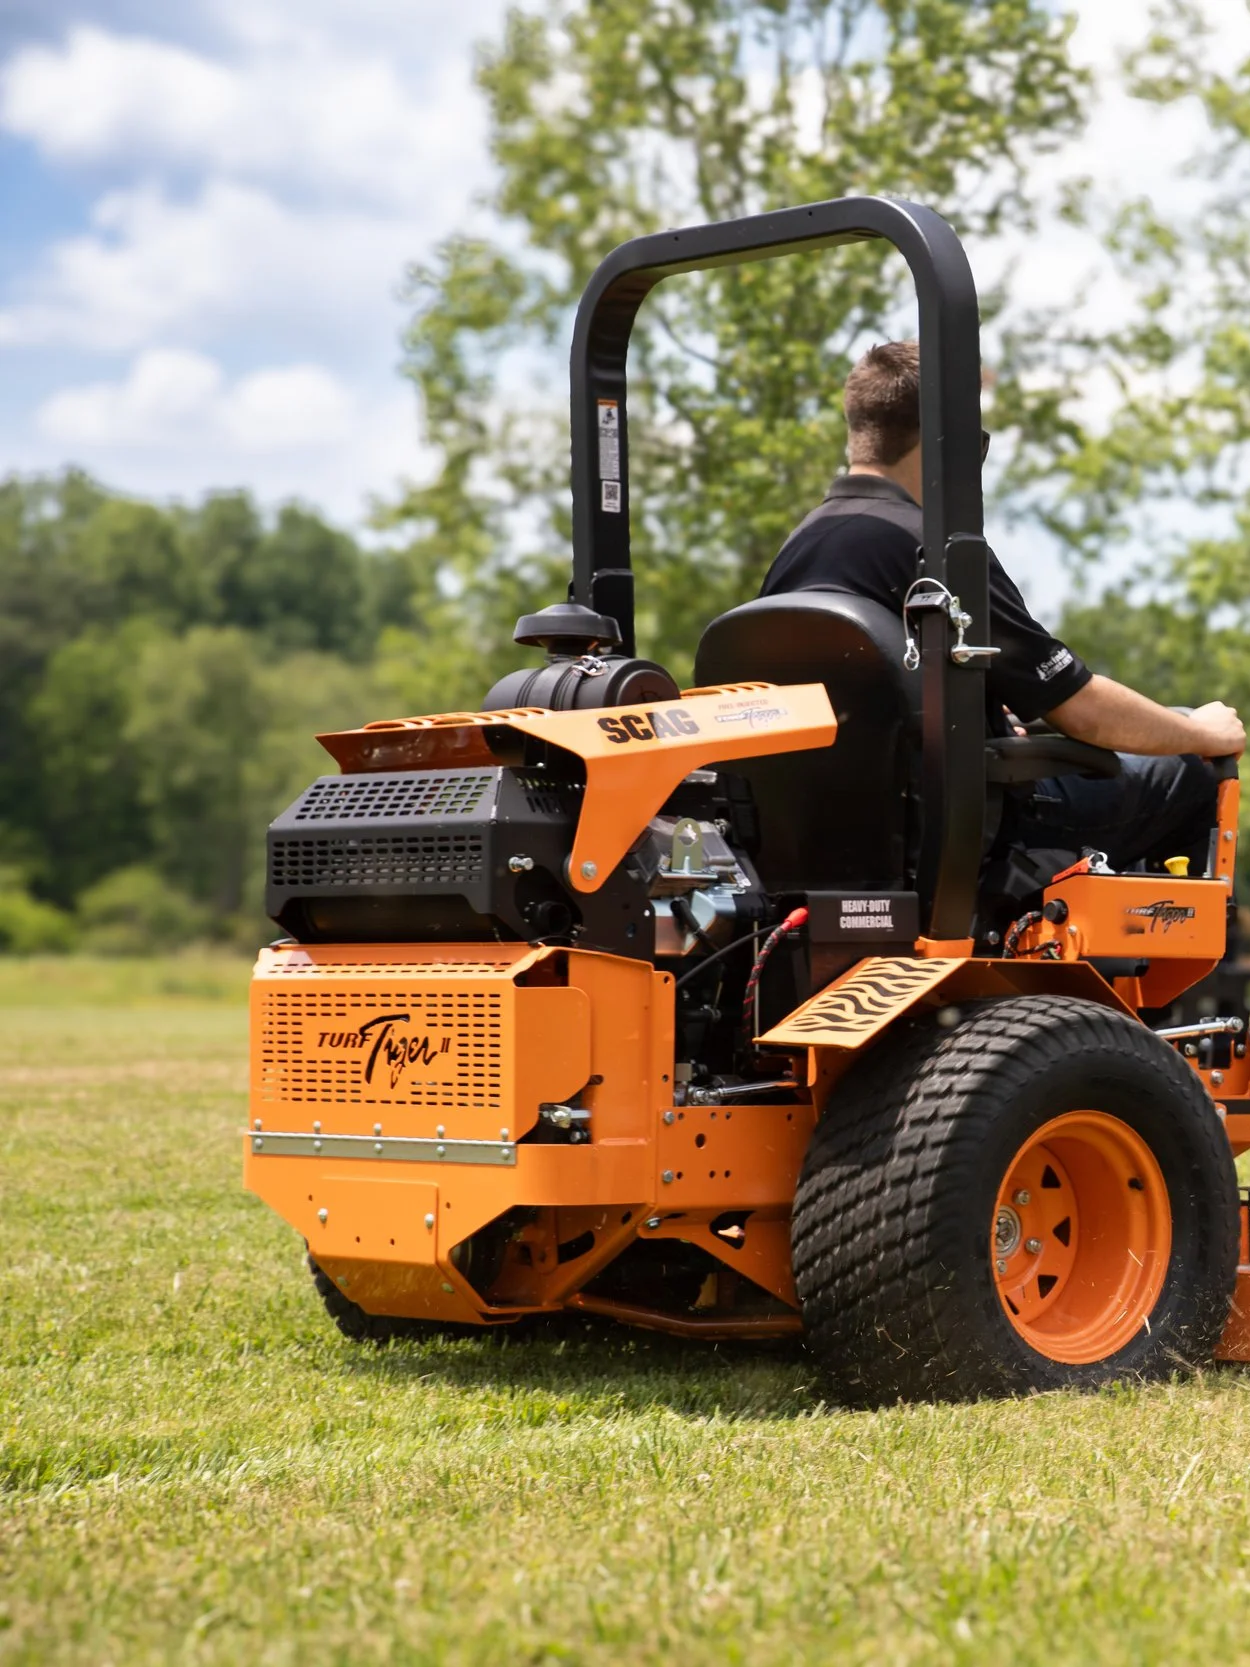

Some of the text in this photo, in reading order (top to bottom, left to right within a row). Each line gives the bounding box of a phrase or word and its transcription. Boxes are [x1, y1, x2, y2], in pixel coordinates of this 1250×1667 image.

[597, 708, 700, 744] SCAG
[841, 900, 891, 913] HEAVY-DUTY
[840, 915, 894, 928] COMMERCIAL
[317, 1032, 373, 1048] TURF
[359, 1013, 438, 1089] Tiger
